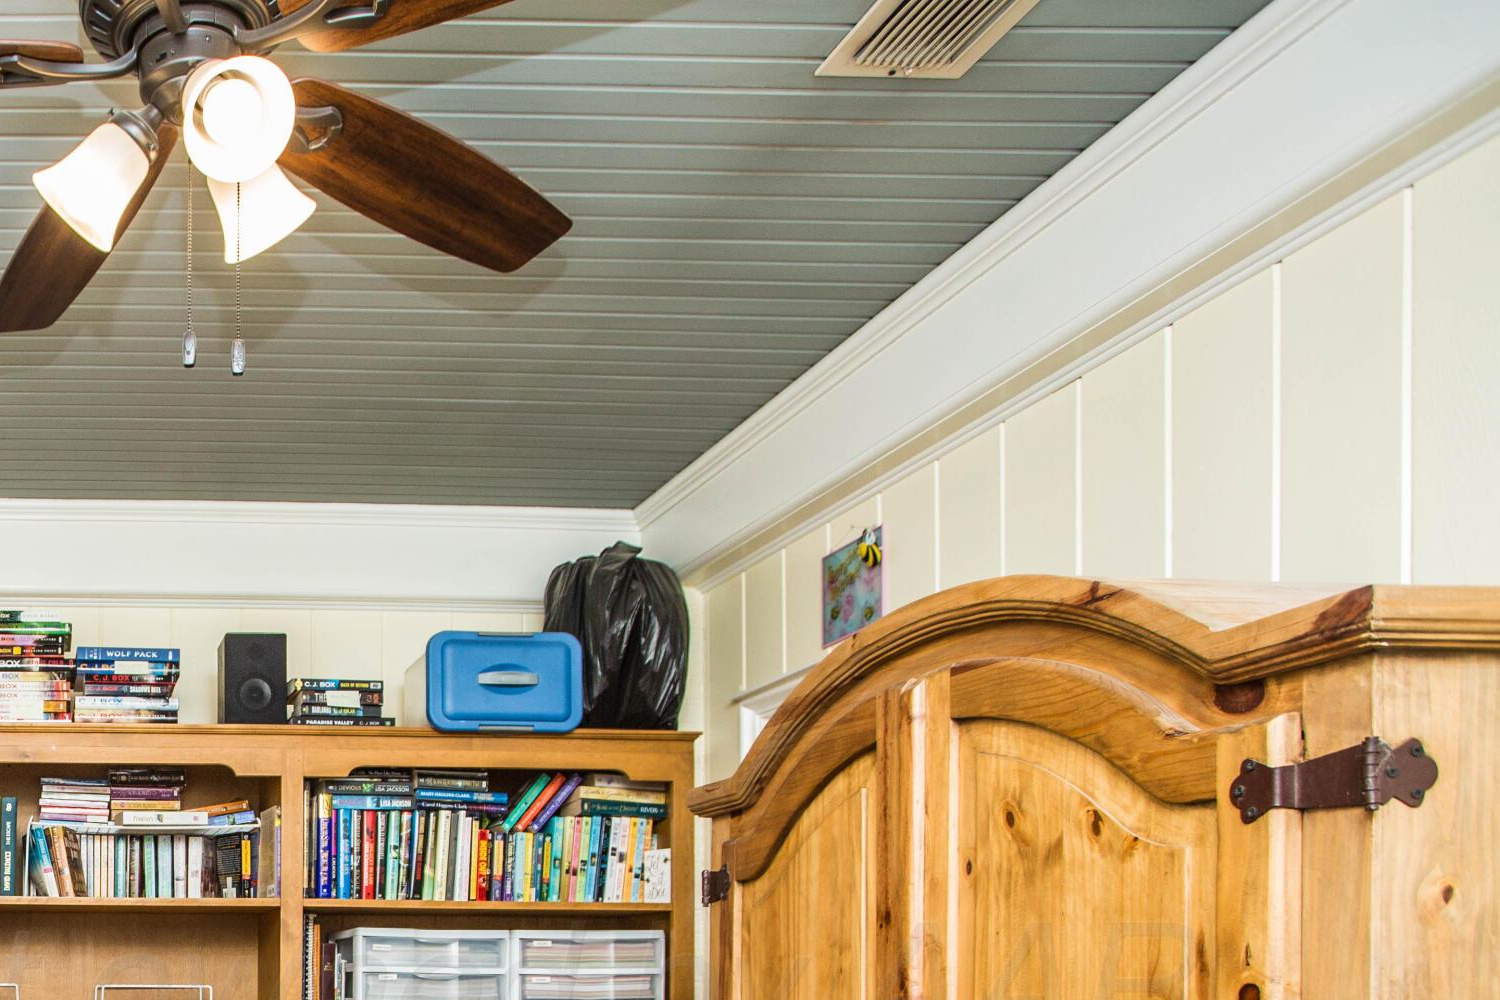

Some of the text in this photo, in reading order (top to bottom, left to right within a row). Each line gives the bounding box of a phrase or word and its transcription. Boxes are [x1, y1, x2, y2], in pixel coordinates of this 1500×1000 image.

[392, 800, 411, 808] JACKSON
[479, 841, 487, 875] INSIDE OUT
